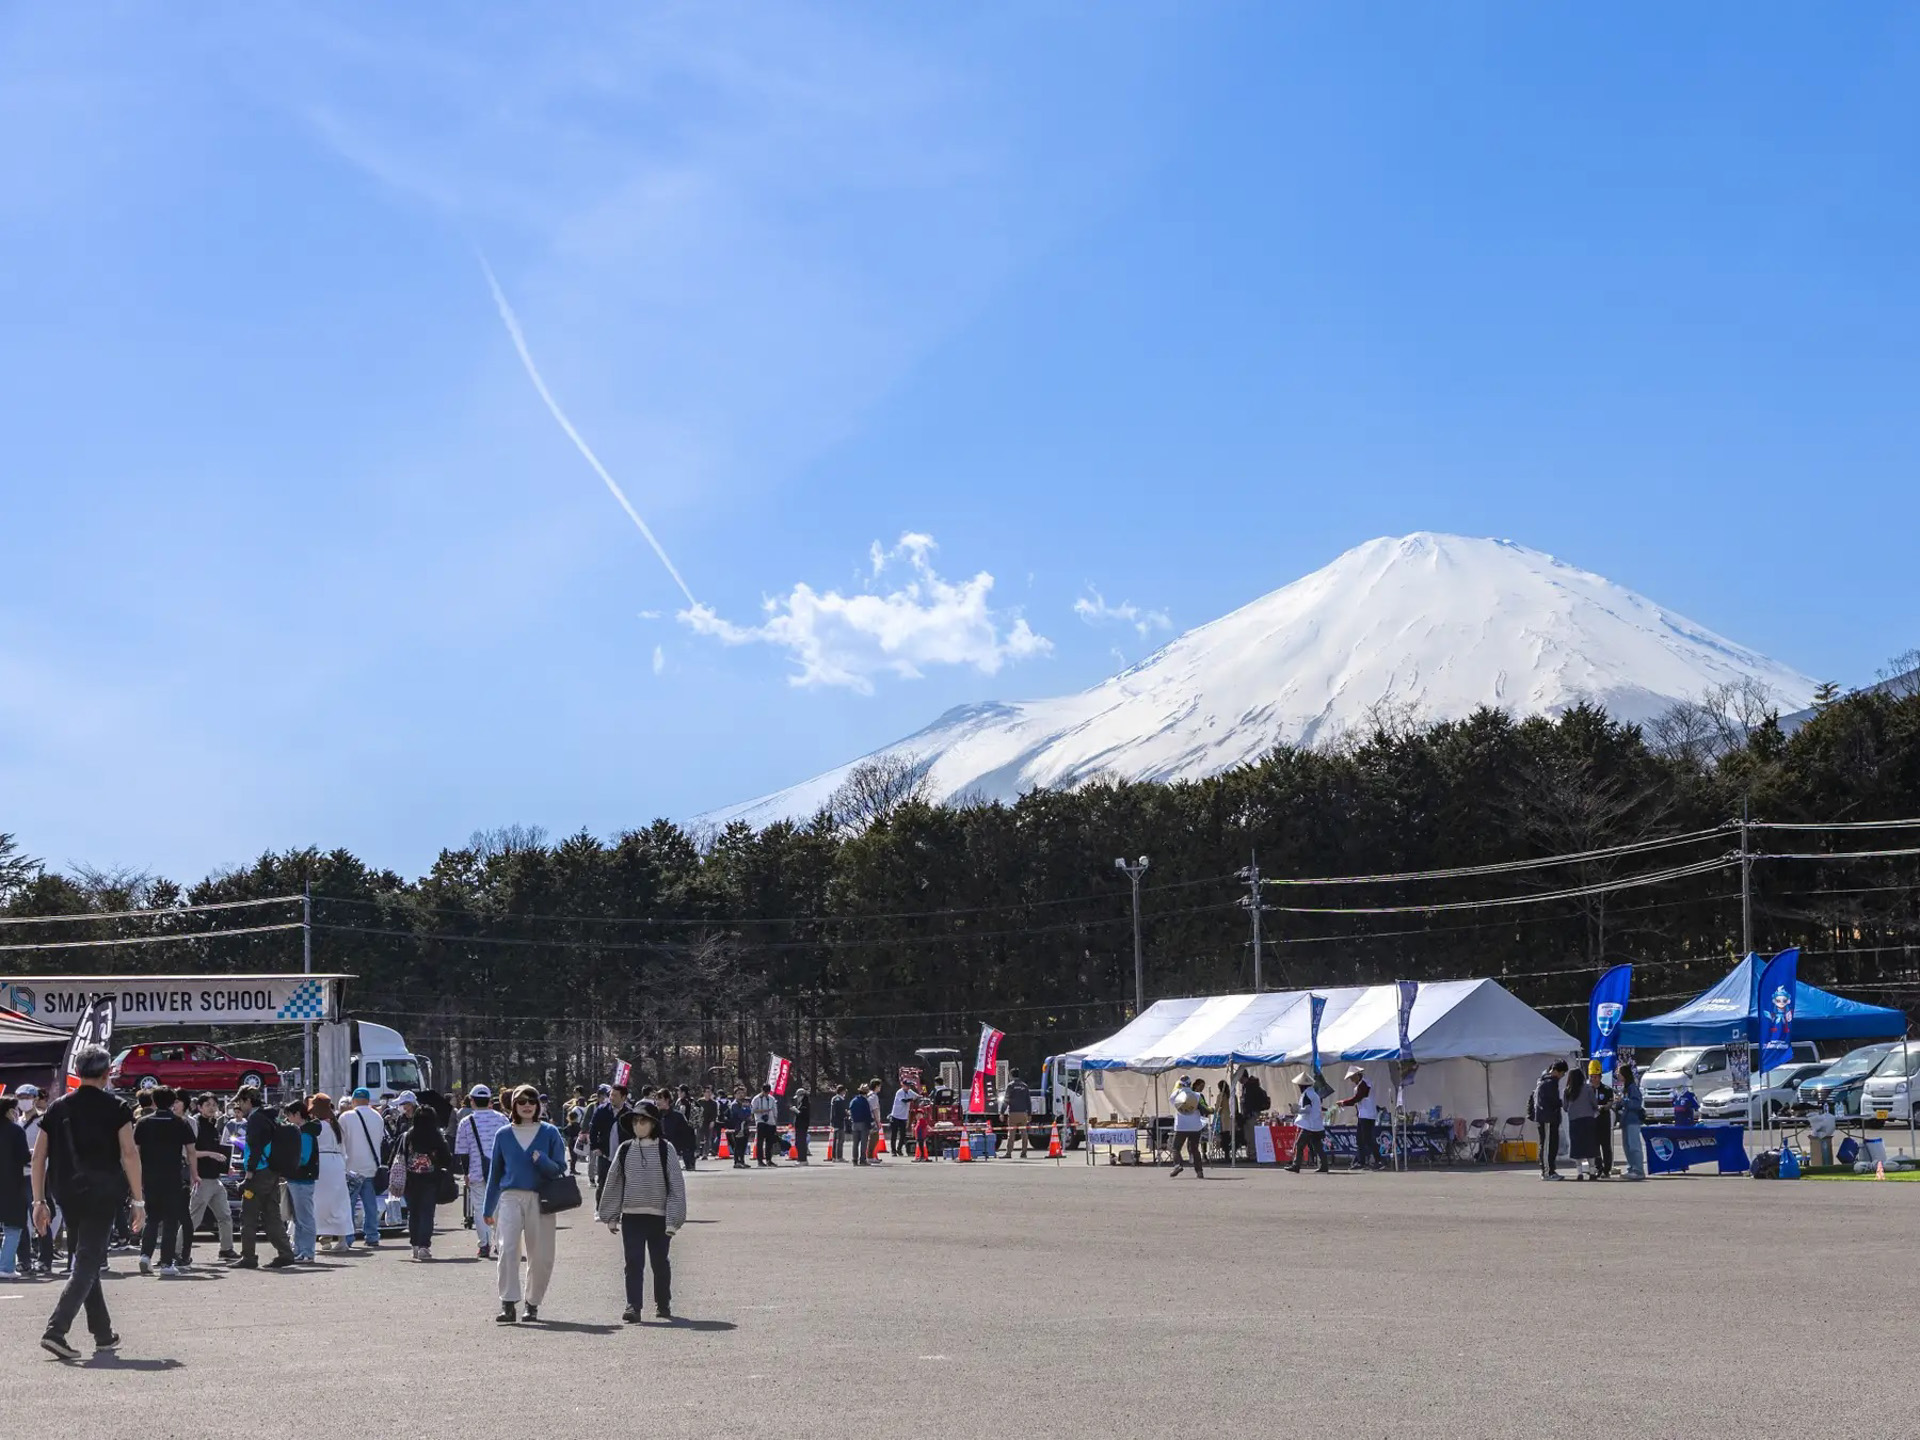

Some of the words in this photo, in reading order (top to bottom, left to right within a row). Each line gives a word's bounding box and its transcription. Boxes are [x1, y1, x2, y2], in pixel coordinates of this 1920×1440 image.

[44, 991, 115, 1013] SMA
[122, 991, 192, 1012] DRIVER
[200, 990, 276, 1011] SCHOOL
